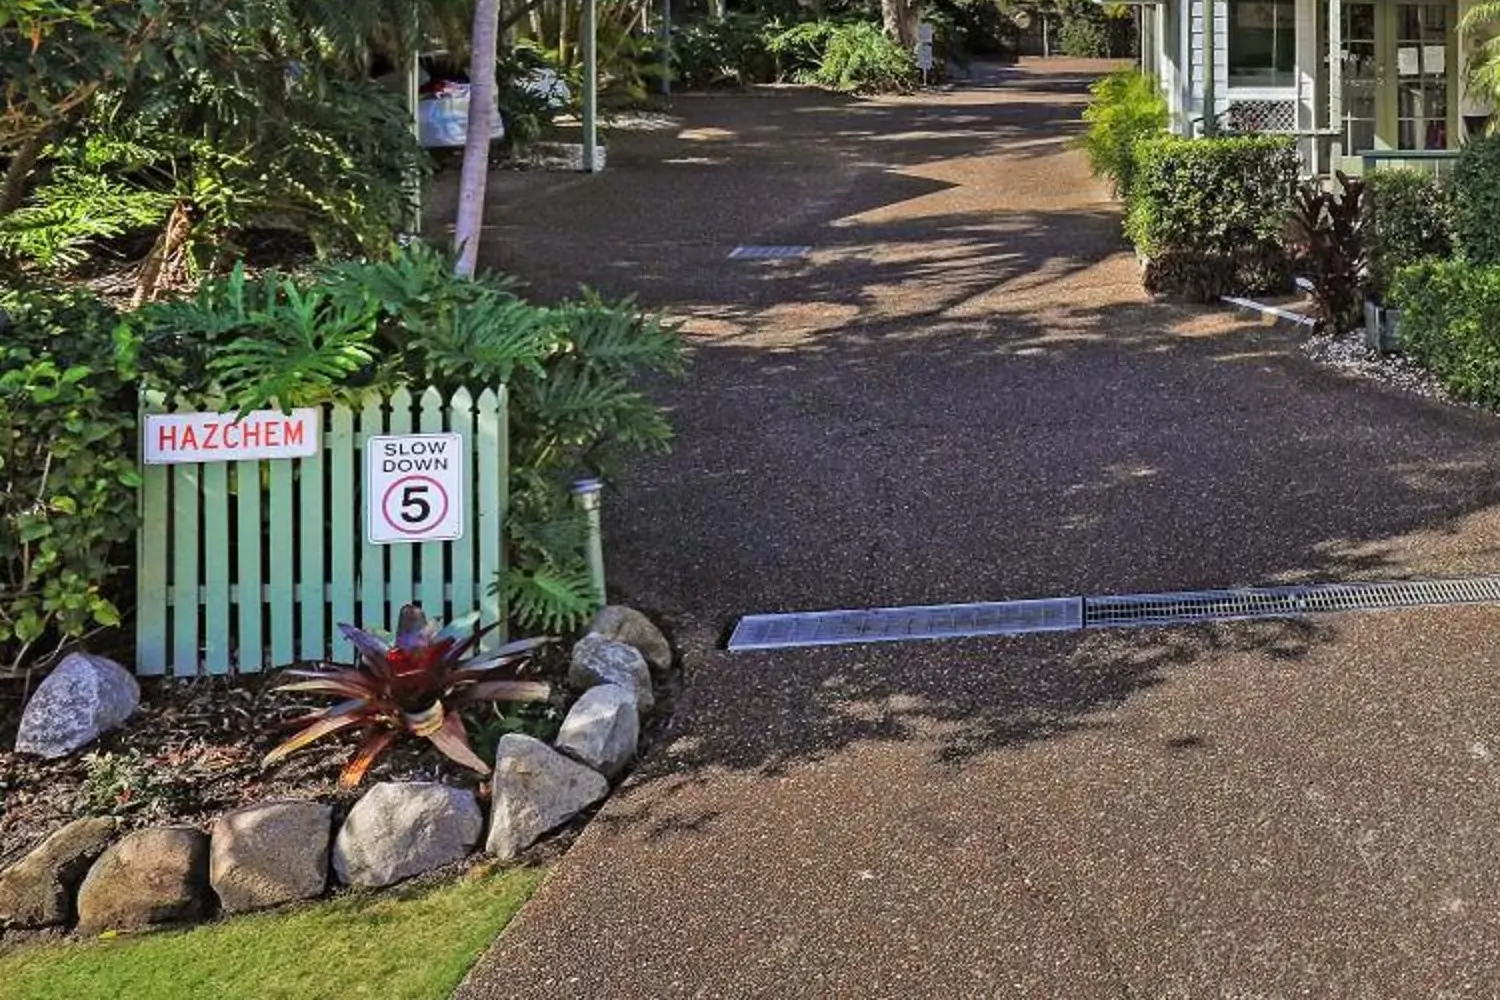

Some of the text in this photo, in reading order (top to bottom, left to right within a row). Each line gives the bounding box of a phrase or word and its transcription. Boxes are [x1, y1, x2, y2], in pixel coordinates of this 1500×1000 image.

[159, 419, 304, 451] HAZCHEM
[384, 442, 446, 457] SLOW
[382, 457, 448, 473] DOWN
[400, 486, 431, 522] 5
